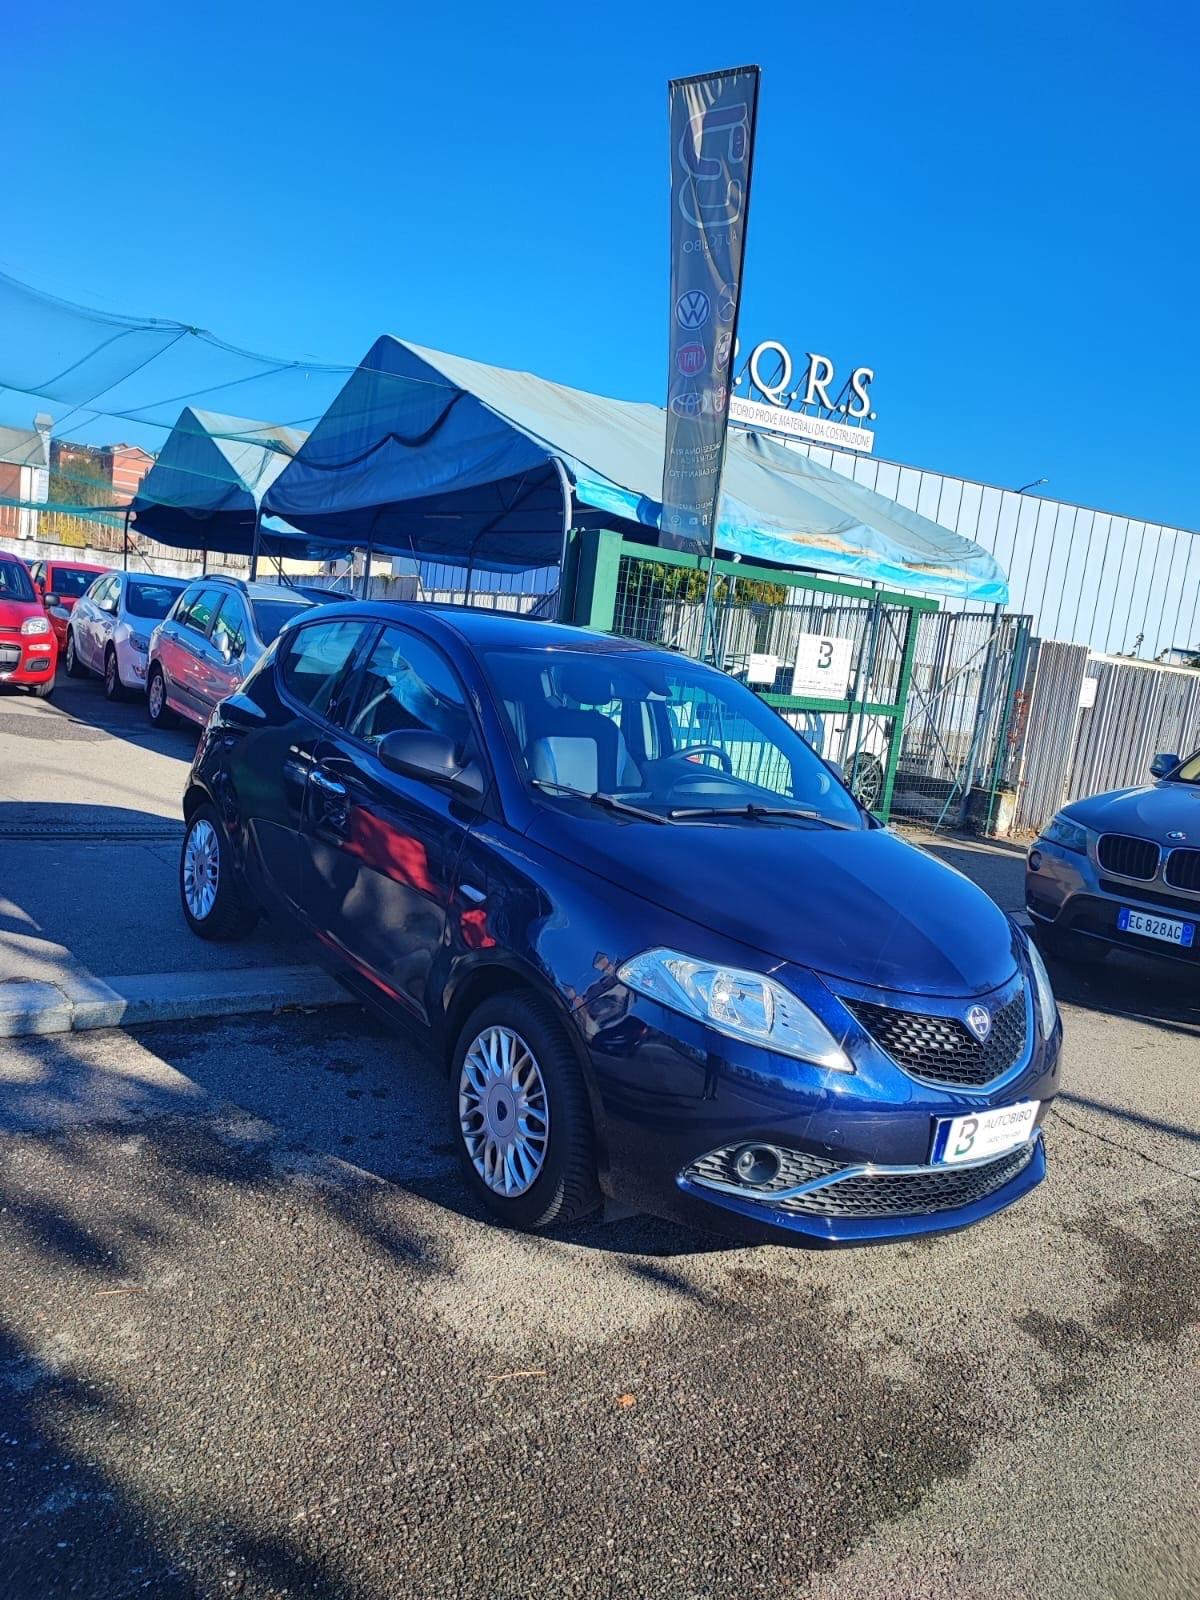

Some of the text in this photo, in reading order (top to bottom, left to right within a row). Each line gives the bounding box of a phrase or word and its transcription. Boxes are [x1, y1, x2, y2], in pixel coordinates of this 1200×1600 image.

[735, 337, 877, 420] .Q.R.S.
[755, 408, 778, 425] PROVE
[778, 414, 814, 434] MATERIALI
[814, 423, 825, 437] DA
[825, 425, 871, 448] COSTRUZIONE
[1129, 914, 1144, 930] EG
[1145, 919, 1181, 940] 828AG
[984, 1109, 1032, 1130] AUTOBIBO
